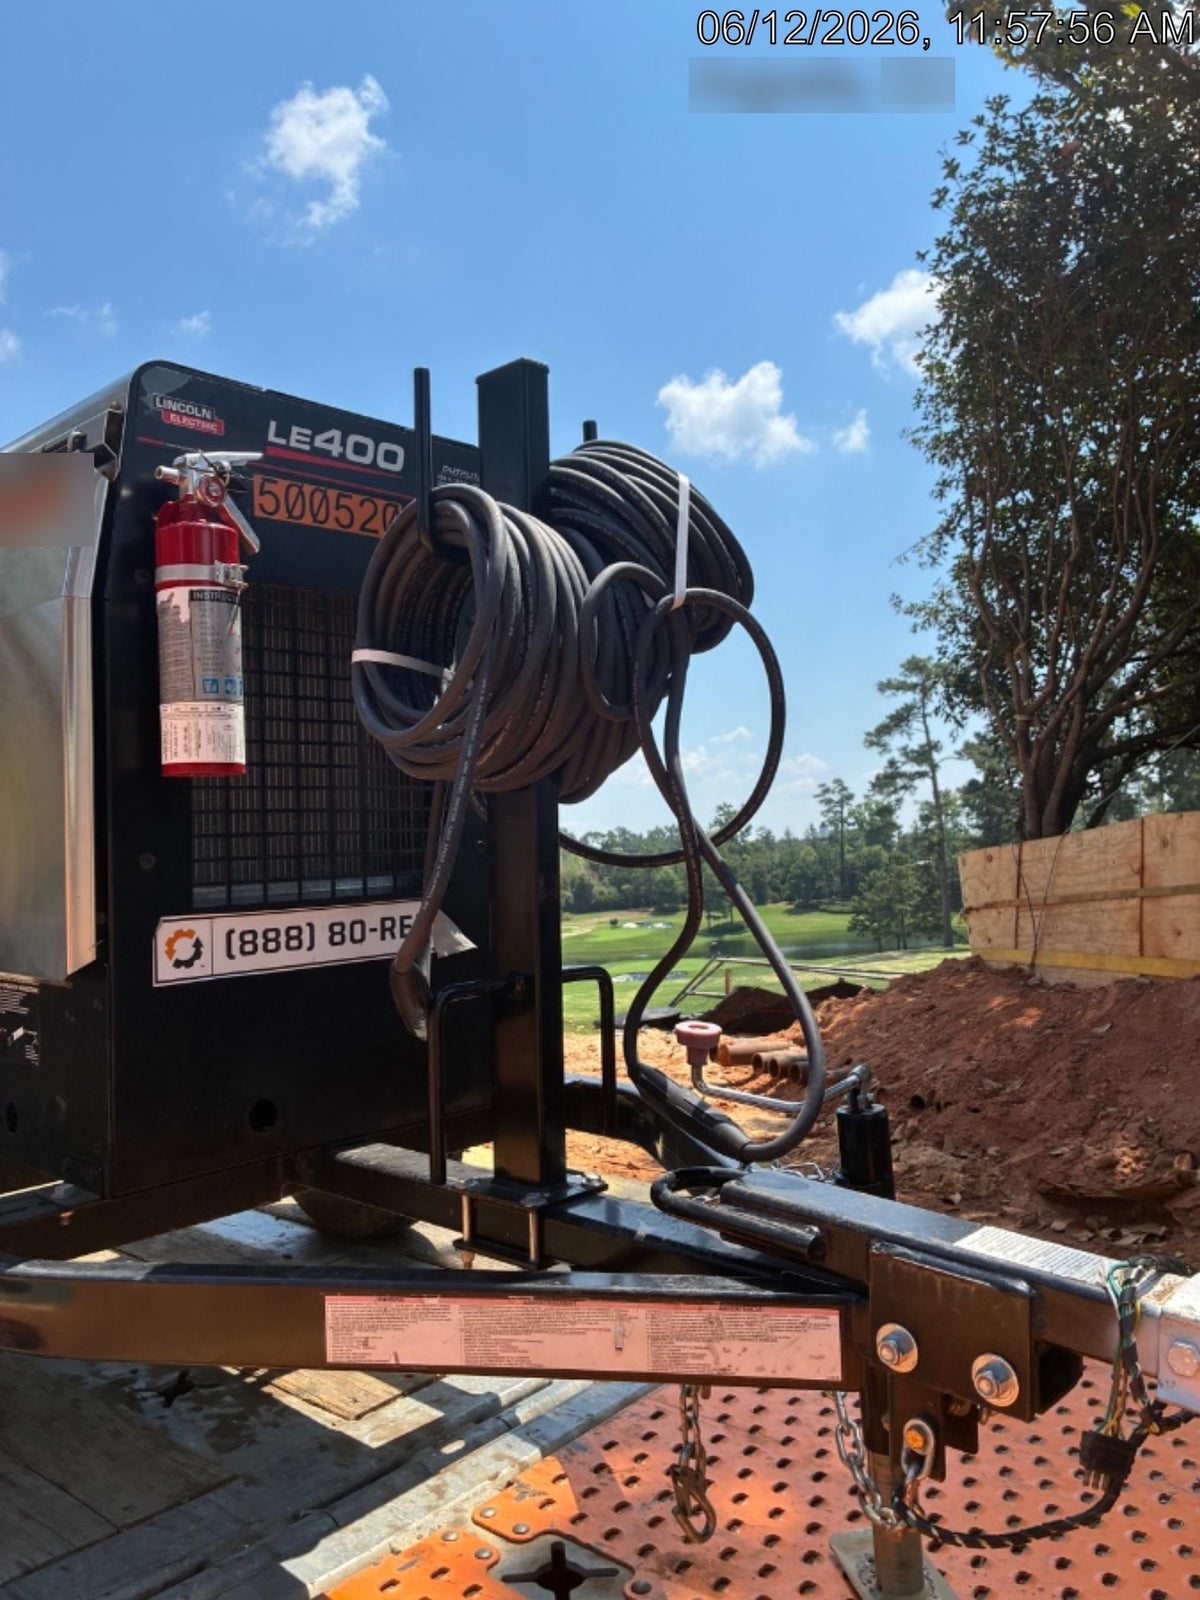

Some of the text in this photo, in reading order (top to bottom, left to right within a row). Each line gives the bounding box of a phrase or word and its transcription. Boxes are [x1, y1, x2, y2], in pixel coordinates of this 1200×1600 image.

[155, 396, 213, 420] LINCOLN
[169, 412, 219, 433] ELECTRIC
[267, 420, 405, 473] LE400
[225, 921, 315, 960] (888)
